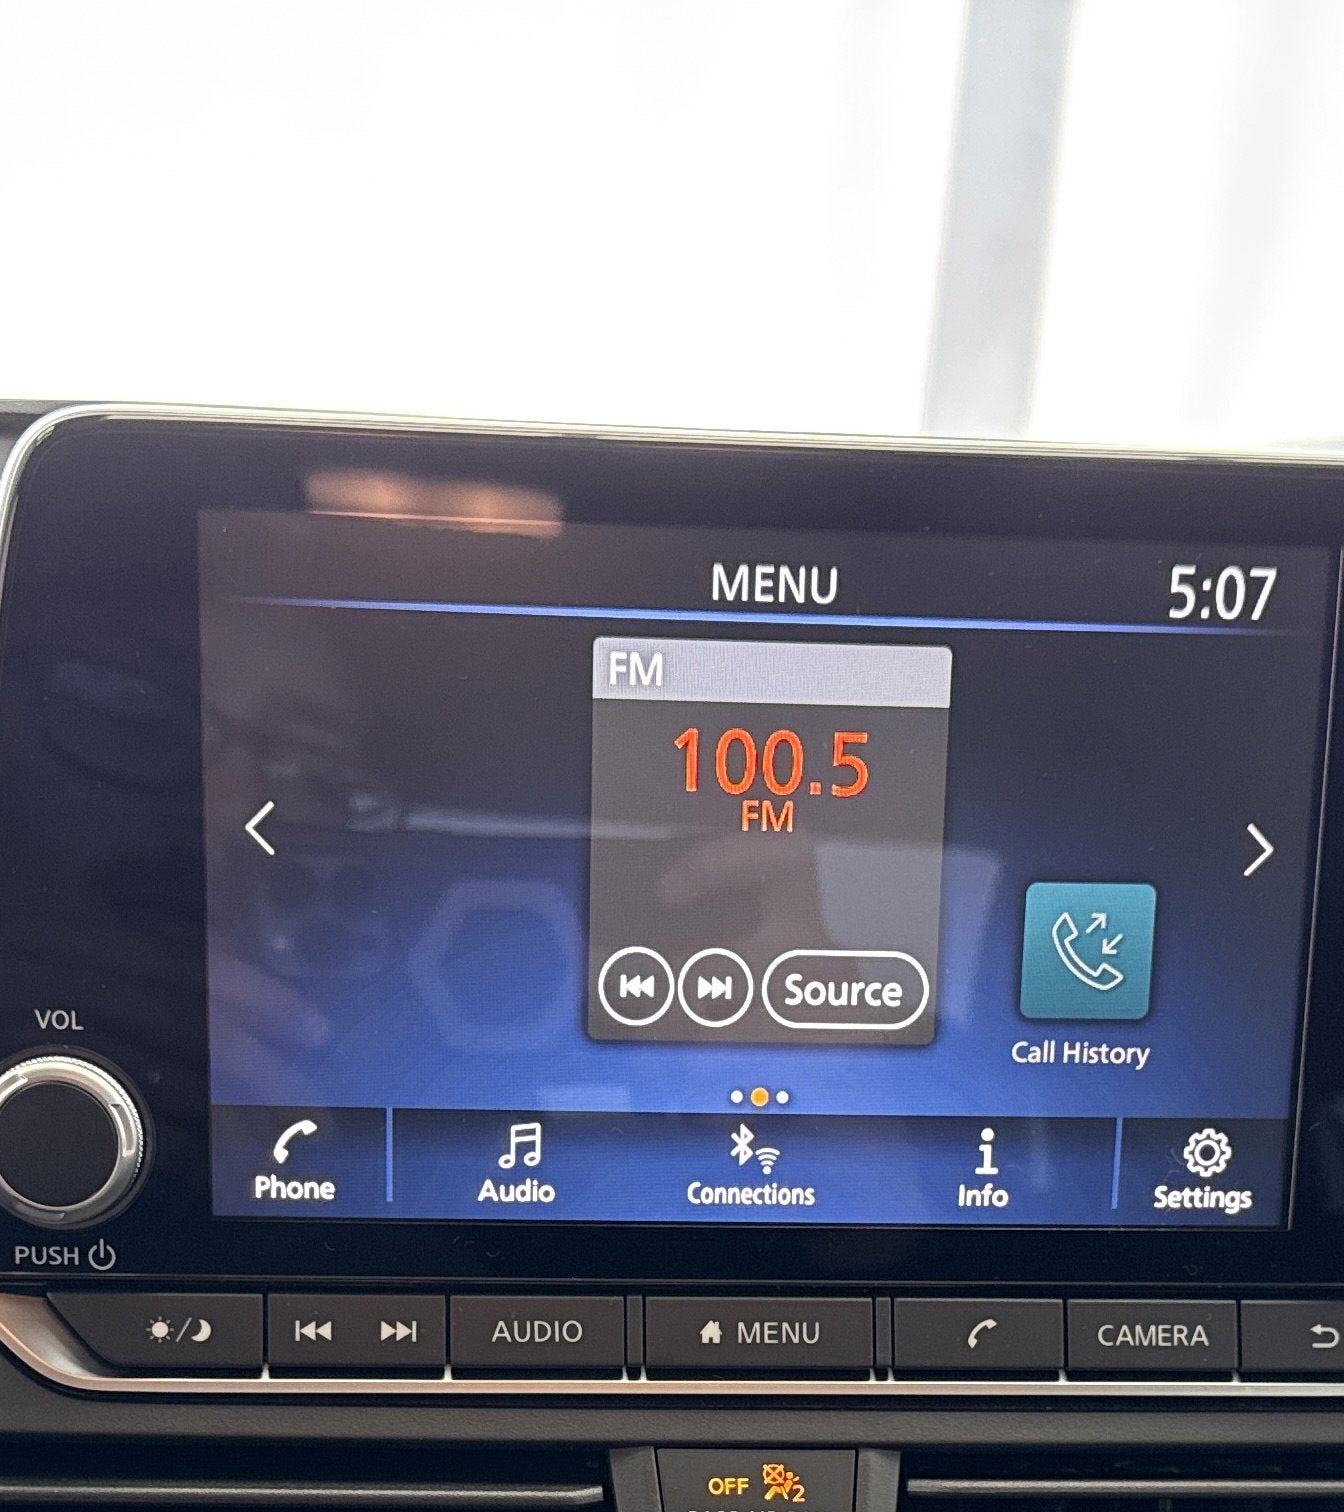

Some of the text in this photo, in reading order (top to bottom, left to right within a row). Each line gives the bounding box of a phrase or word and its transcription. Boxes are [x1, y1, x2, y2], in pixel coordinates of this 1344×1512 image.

[711, 564, 839, 604] MENU
[1169, 565, 1277, 620] 5:07
[609, 652, 663, 687] FM
[673, 729, 869, 798] 100.5
[742, 800, 794, 833] FM
[785, 973, 903, 1010] Source
[35, 1010, 84, 1031] VOL
[1012, 1041, 1150, 1069] Call History
[255, 1176, 336, 1200] Phone
[478, 1179, 555, 1204] Audio
[687, 1180, 816, 1208] Connections
[958, 1183, 1009, 1208] Info
[1154, 1184, 1252, 1213] Settings
[15, 1246, 80, 1266] PUSH
[492, 1320, 583, 1342] AUDIO
[738, 1322, 820, 1344] MENU
[1098, 1324, 1209, 1347] CAMERA
[708, 1478, 749, 1496] OFF
